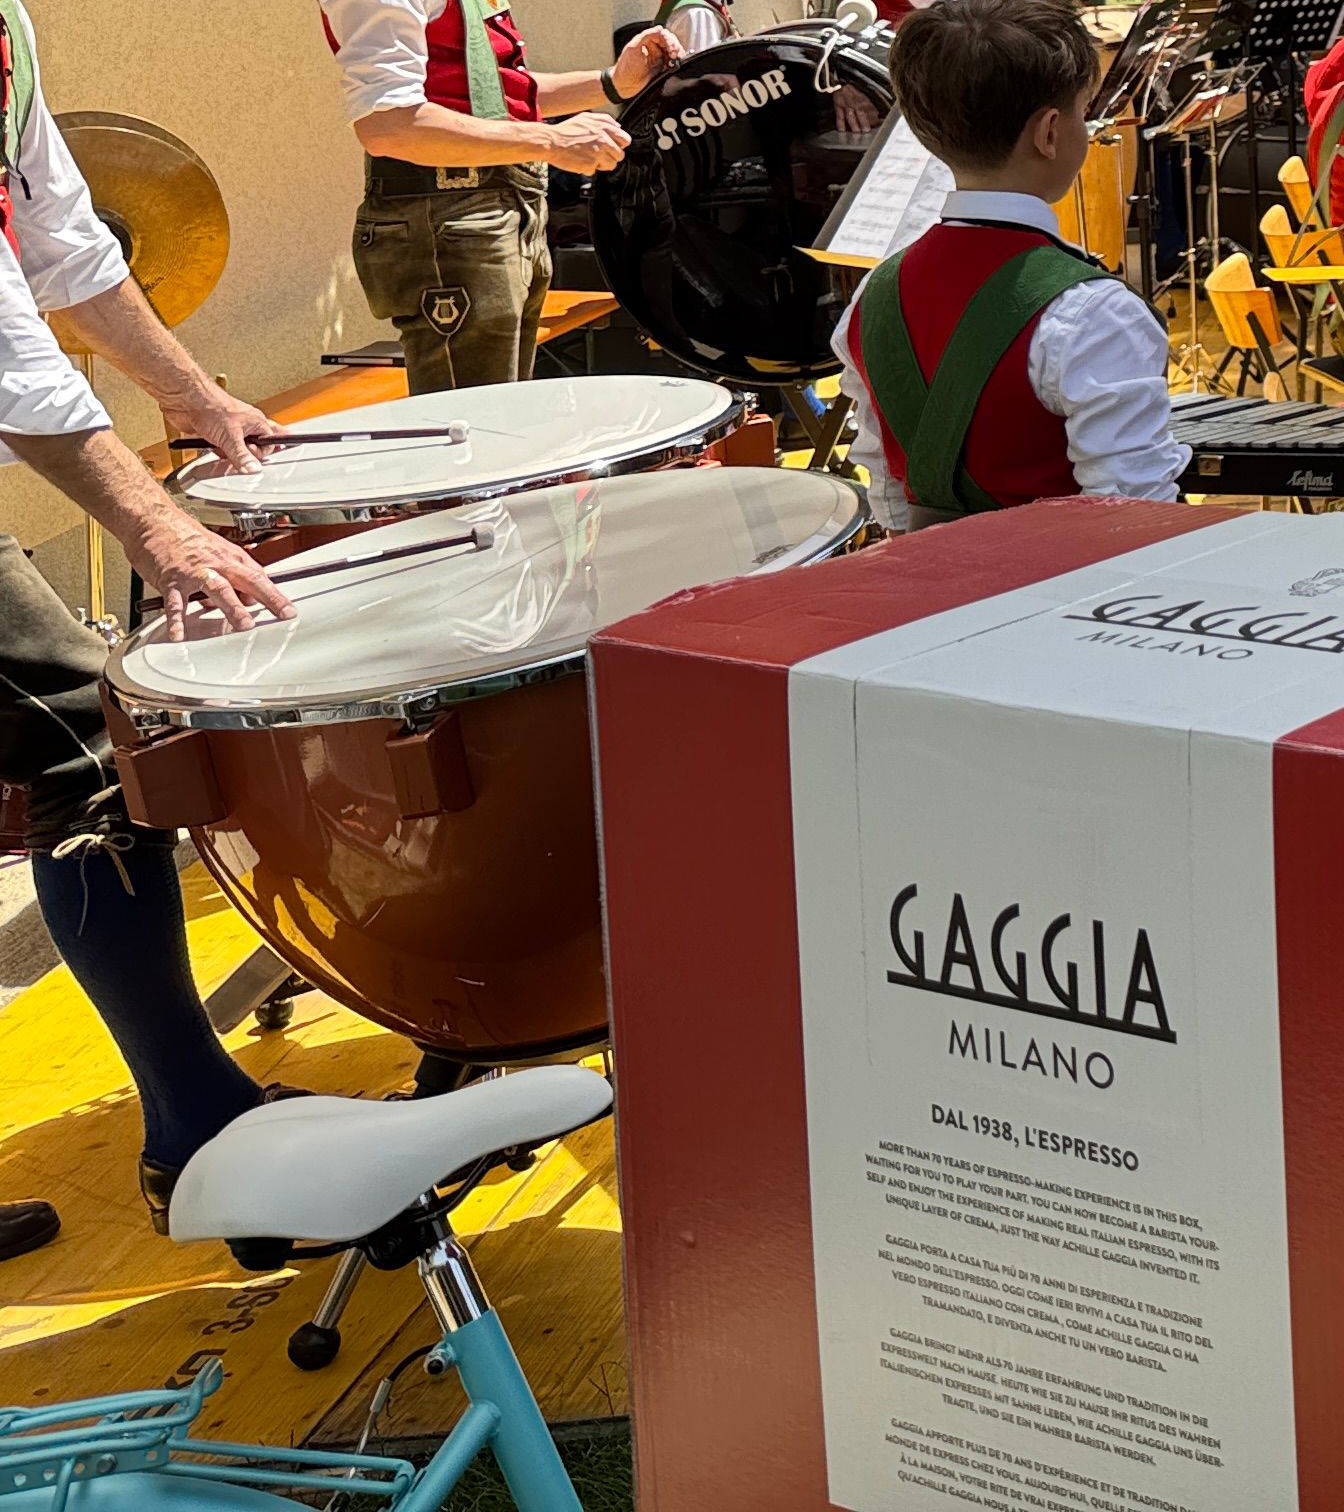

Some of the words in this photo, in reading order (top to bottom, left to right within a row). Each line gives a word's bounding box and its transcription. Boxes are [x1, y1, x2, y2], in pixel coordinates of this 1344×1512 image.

[681, 69, 792, 137] SONOR
[1074, 631, 1254, 660] MILANO
[887, 883, 1177, 1045] GAGGIA
[948, 1019, 1114, 1089] MILANO
[878, 1138, 905, 1156] MORE
[905, 1145, 930, 1162] THAN
[931, 1152, 942, 1165] 70
[942, 1154, 971, 1172] YEARS
[972, 1162, 985, 1176] OF
[1073, 1187, 1131, 1213] EXPERIENCE
[1132, 1202, 1142, 1215] IS
[1142, 1204, 1154, 1219] IN
[1155, 1208, 1177, 1224] THIS
[931, 1104, 968, 1132] DAL
[972, 1113, 1019, 1148] 1938,
[1024, 1125, 1139, 1172] L'ESPRESSO
[864, 1152, 901, 1172] WAITING
[902, 1162, 921, 1177] FOR
[920, 1166, 941, 1182] YOU
[941, 1172, 955, 1186] TO
[955, 1175, 978, 1192] PLAY
[977, 1181, 1004, 1198] YOUR
[1029, 1194, 1050, 1210] YOU
[1051, 1200, 1073, 1216] CAN
[1073, 1205, 1098, 1223] NOW
[1098, 1212, 1139, 1233] BECOME
[1147, 1224, 1188, 1246] BARISTA
[866, 1170, 886, 1186] SELF
[887, 1175, 907, 1191] AND
[908, 1181, 936, 1198] ENJOY
[937, 1188, 955, 1203] THE
[956, 1193, 1011, 1218] EXPERIENCE
[1011, 1207, 1025, 1222] OF
[1025, 1211, 1064, 1232] MAKING
[1065, 1221, 1089, 1238] REAL
[1090, 1227, 1126, 1248] ITALIAN
[1178, 1250, 1204, 1268] WITH
[1205, 1257, 1220, 1272] ITS
[885, 1192, 920, 1211] UNIQUE
[921, 1201, 948, 1219] LAYER
[949, 1209, 962, 1223] OF
[999, 1222, 1021, 1238] JUST
[1021, 1228, 1040, 1243] THE
[1040, 1233, 1060, 1249] WAY
[1061, 1238, 1100, 1259] ACHILLE
[1101, 1248, 1138, 1269] GAGGIA
[1139, 1258, 1187, 1282] INVENTED
[877, 1248, 895, 1263] NEL
[895, 1252, 931, 1273] MONDO
[1001, 1281, 1025, 1299] OGGI
[1026, 1288, 1054, 1306] COME
[1055, 1296, 1073, 1312] IERI
[1075, 1301, 1104, 1320] RIVIVI
[1113, 1312, 1139, 1330] CASA
[1139, 1319, 1159, 1335] TUA
[1159, 1324, 1169, 1338] IL
[1170, 1327, 1193, 1344] RITO
[1194, 1334, 1213, 1350] DEL
[885, 1232, 919, 1252] GAGGIA
[919, 1242, 949, 1260] PORTA
[957, 1251, 981, 1269] CASA
[982, 1258, 1000, 1274] TUA
[1017, 1268, 1028, 1281] DI
[1029, 1271, 1040, 1285] 70
[1041, 1274, 1066, 1292] ANNI
[1067, 1281, 1078, 1295] DI
[1079, 1284, 1136, 1310] ESPERIENZA
[1144, 1302, 1203, 1328] TRADIZIONE
[891, 1268, 916, 1286] VERO
[917, 1276, 961, 1298] ESPRESSO
[962, 1288, 1003, 1310] ITALIANO
[1004, 1299, 1025, 1316] CON
[1065, 1316, 1093, 1335] COME
[1093, 1324, 1133, 1346] ACHILLE
[1133, 1335, 1171, 1357] GAGGIA
[1172, 1346, 1183, 1360] CI
[1183, 1349, 1199, 1365] HA
[994, 1314, 1033, 1336] DIVENTA
[1033, 1325, 1067, 1345] ANCHE
[1067, 1335, 1080, 1349] TU
[1081, 1338, 1096, 1354] UN
[1097, 1343, 1124, 1361] VERO
